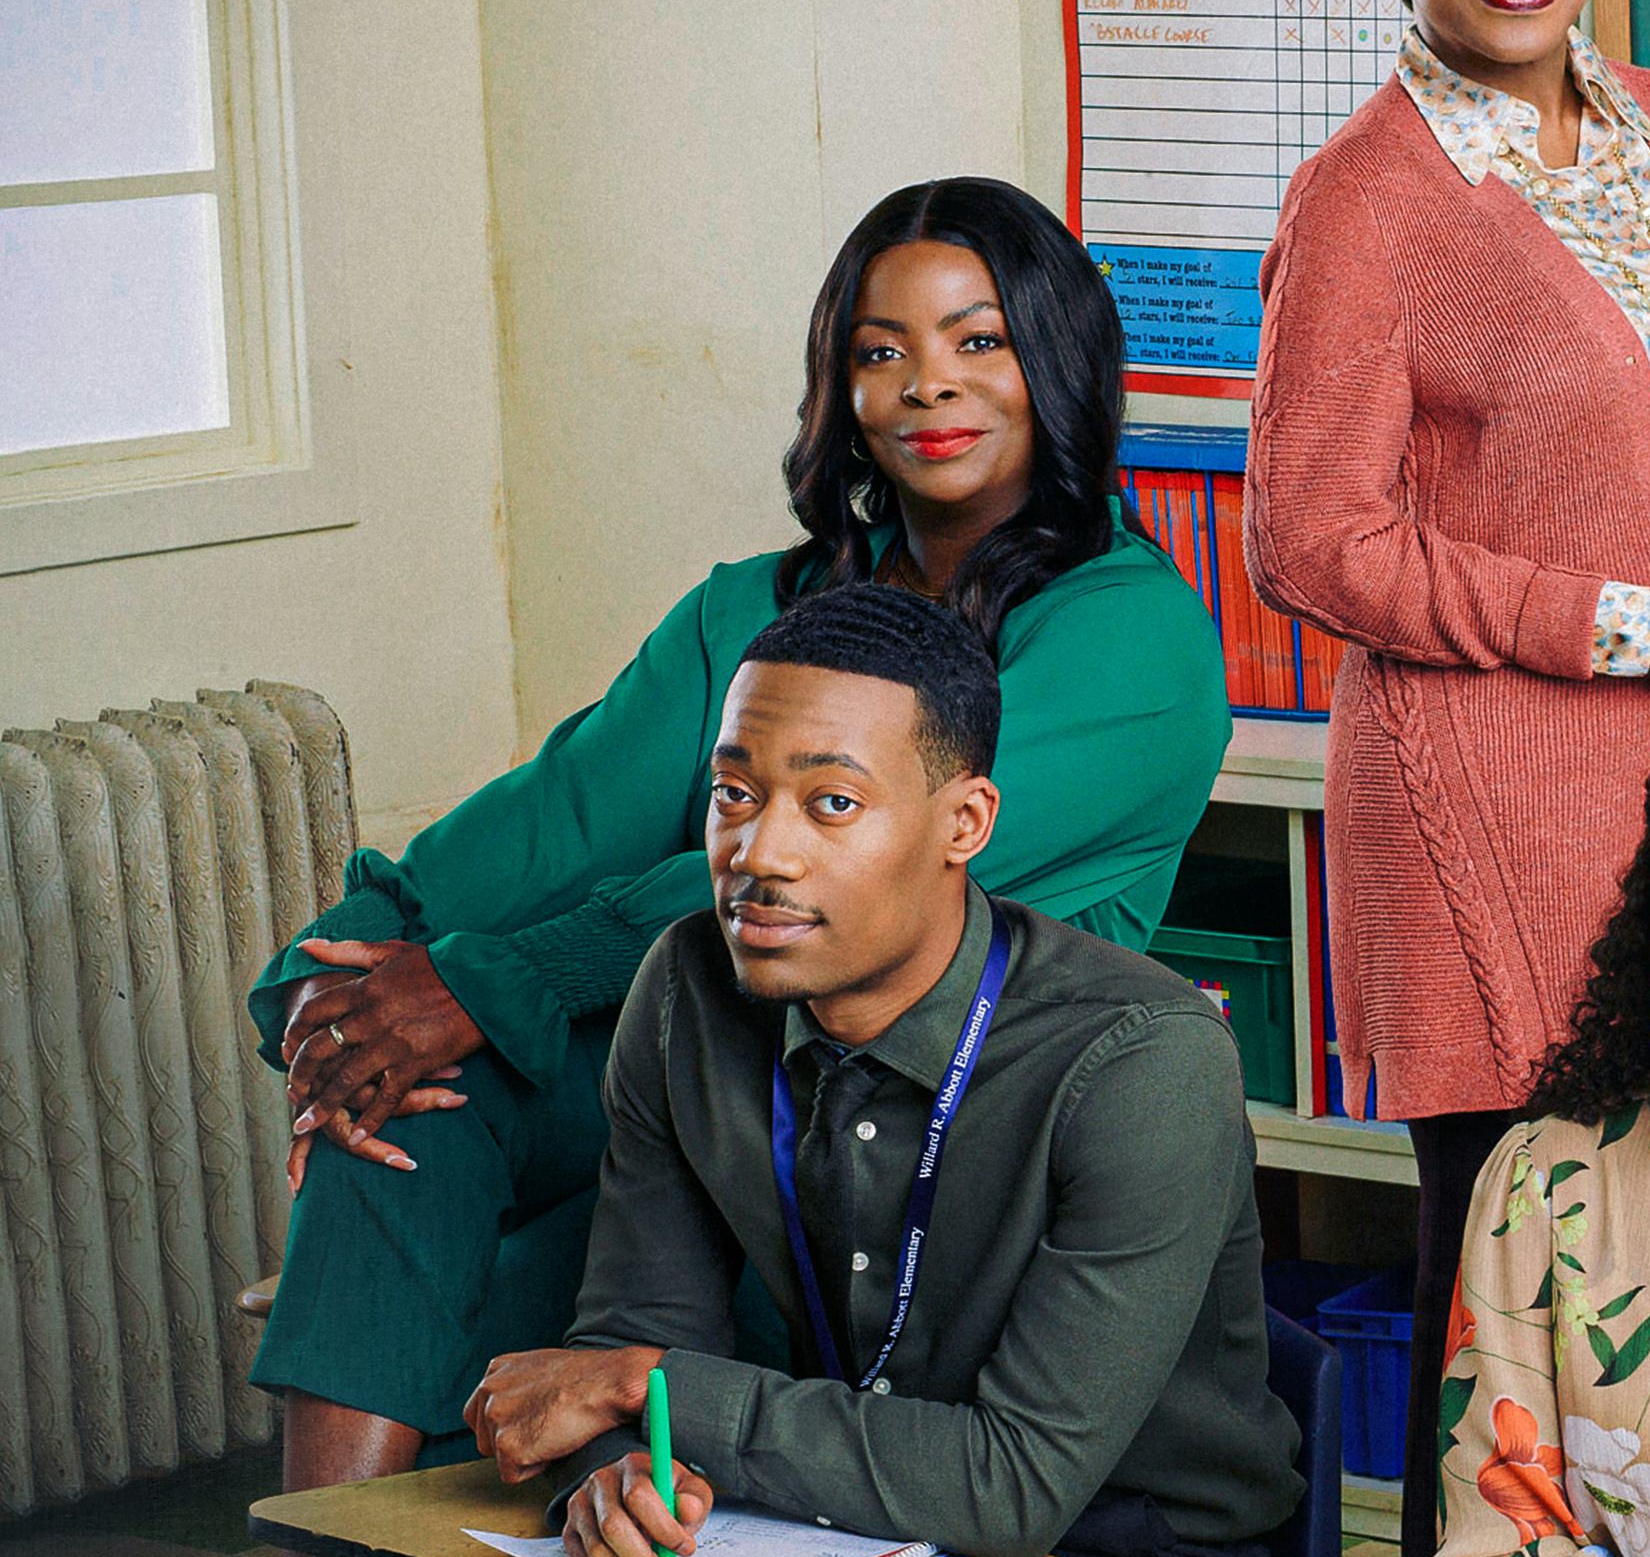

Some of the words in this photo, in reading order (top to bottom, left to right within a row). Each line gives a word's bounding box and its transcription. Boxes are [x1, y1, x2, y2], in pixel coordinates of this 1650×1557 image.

[1170, 262, 1182, 274] my
[1168, 276, 1183, 286] will
[1117, 294, 1140, 306] When
[1171, 299, 1183, 311] my
[1169, 312, 1185, 323] will
[1172, 336, 1185, 347] my
[1170, 349, 1186, 360] will
[953, 996, 992, 1068] Elementary
[938, 1070, 963, 1114] Abbott
[931, 1115, 946, 1131] R.
[918, 1131, 941, 1179] Willard
[889, 1299, 909, 1338] Abbott
[899, 1226, 925, 1297] Elementary
